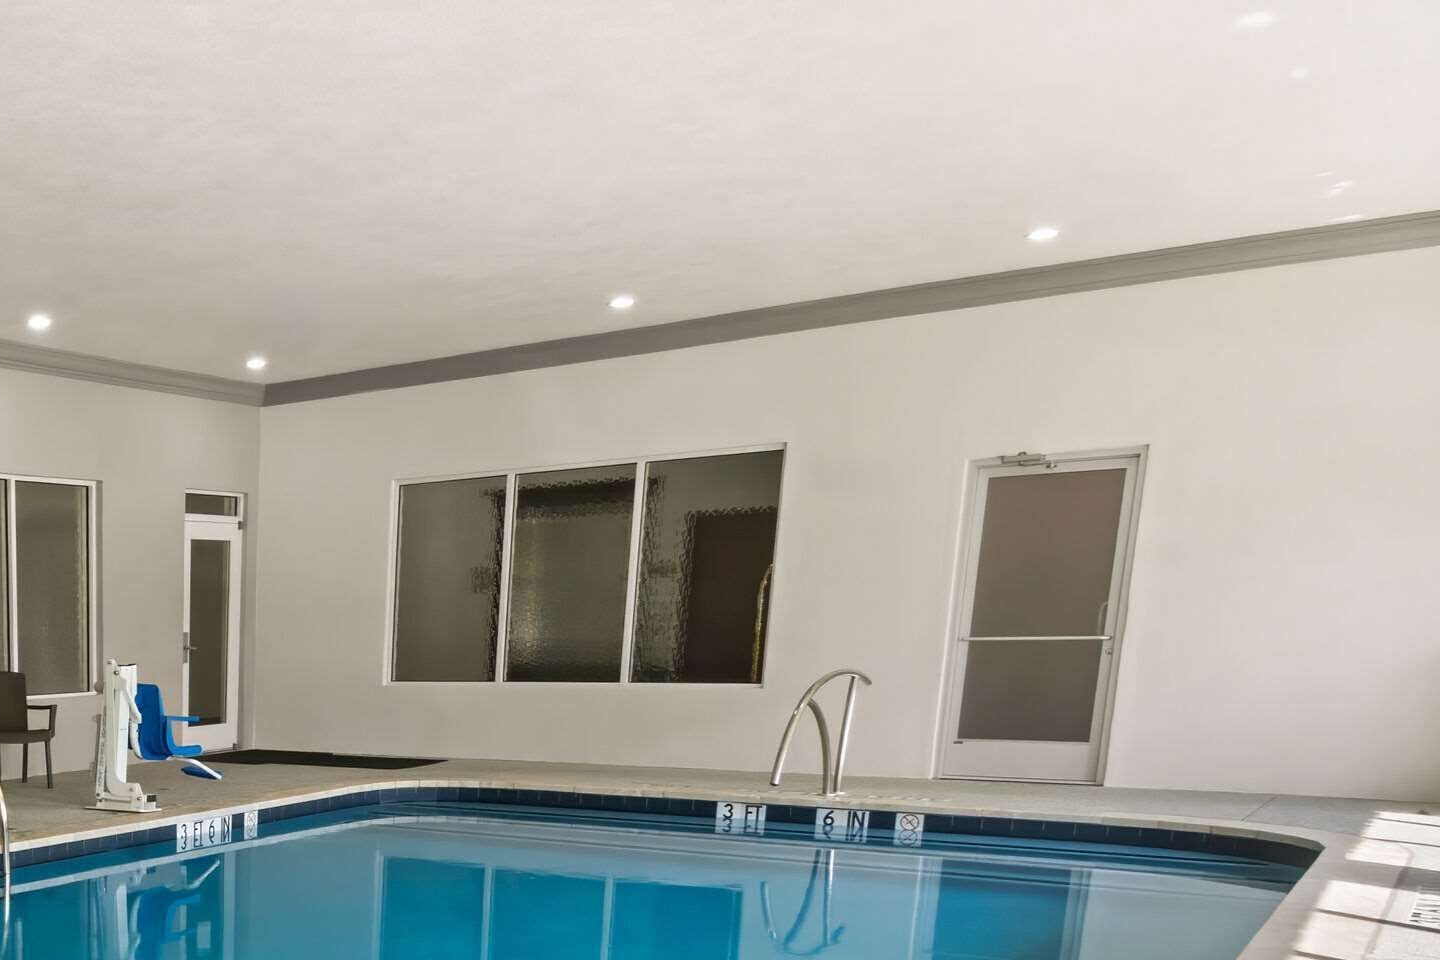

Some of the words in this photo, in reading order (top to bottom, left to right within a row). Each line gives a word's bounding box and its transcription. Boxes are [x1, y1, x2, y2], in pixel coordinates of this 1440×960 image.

[745, 805, 762, 820] FT
[823, 810, 834, 826] 6
[847, 811, 865, 828] IN
